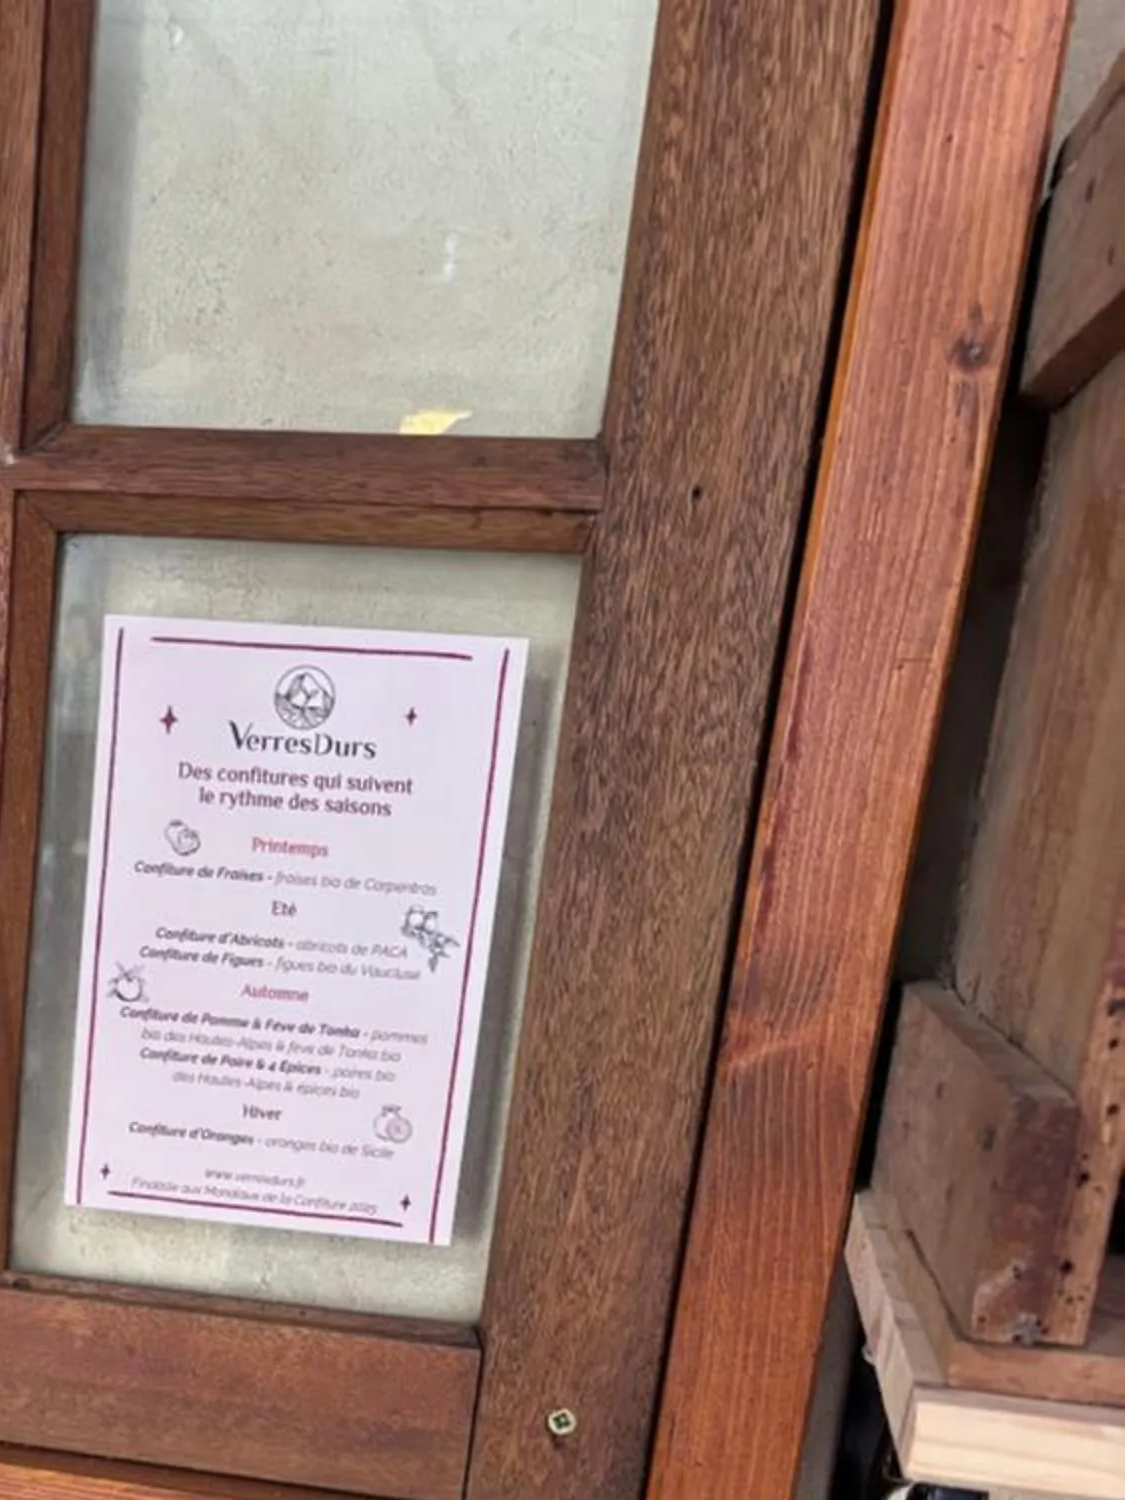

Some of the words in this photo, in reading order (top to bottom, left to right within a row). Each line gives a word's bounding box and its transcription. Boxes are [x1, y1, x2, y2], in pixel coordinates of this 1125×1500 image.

[229, 720, 377, 759] VerresDurs
[178, 761, 213, 781] Des
[217, 766, 308, 787] confitures
[314, 773, 341, 791] qui
[347, 774, 413, 795] suivent
[199, 786, 215, 804] le
[219, 790, 283, 810] rythme
[288, 793, 319, 812] des
[325, 797, 392, 817] saisons
[252, 836, 328, 859] Printemps
[134, 860, 195, 878] Confiture
[197, 866, 213, 879] de
[216, 866, 264, 882] Fraises
[275, 870, 317, 886] fraises
[321, 875, 341, 889] bio
[344, 877, 361, 890] de
[364, 877, 437, 896] Carpentras
[155, 926, 216, 943] Confiture
[218, 932, 284, 949] d'Abricots
[296, 940, 348, 955] abricots
[351, 944, 369, 956] de
[371, 943, 408, 959] PACA
[139, 945, 199, 962] Confiture
[201, 951, 219, 965] de
[221, 953, 264, 969] Figues
[275, 956, 314, 973] figues
[317, 961, 338, 974] bio
[340, 963, 357, 976] du
[361, 964, 421, 981] Vaucluse
[240, 984, 309, 1002] Automne
[120, 1005, 179, 1022] Confiture
[181, 1011, 198, 1024] de
[201, 1012, 249, 1028] Pomme
[298, 1022, 316, 1035] de
[319, 1022, 360, 1039] Tonka
[371, 1029, 428, 1045] pommes
[140, 1047, 198, 1063] Confiture
[201, 1053, 218, 1066] de
[220, 1054, 253, 1069] Poire
[164, 1030, 186, 1043] des
[317, 1043, 335, 1056] de
[242, 1103, 283, 1121] Hiver
[128, 1120, 187, 1138] Confiture
[189, 1127, 254, 1146] d'Oranges
[341, 1142, 358, 1156] de
